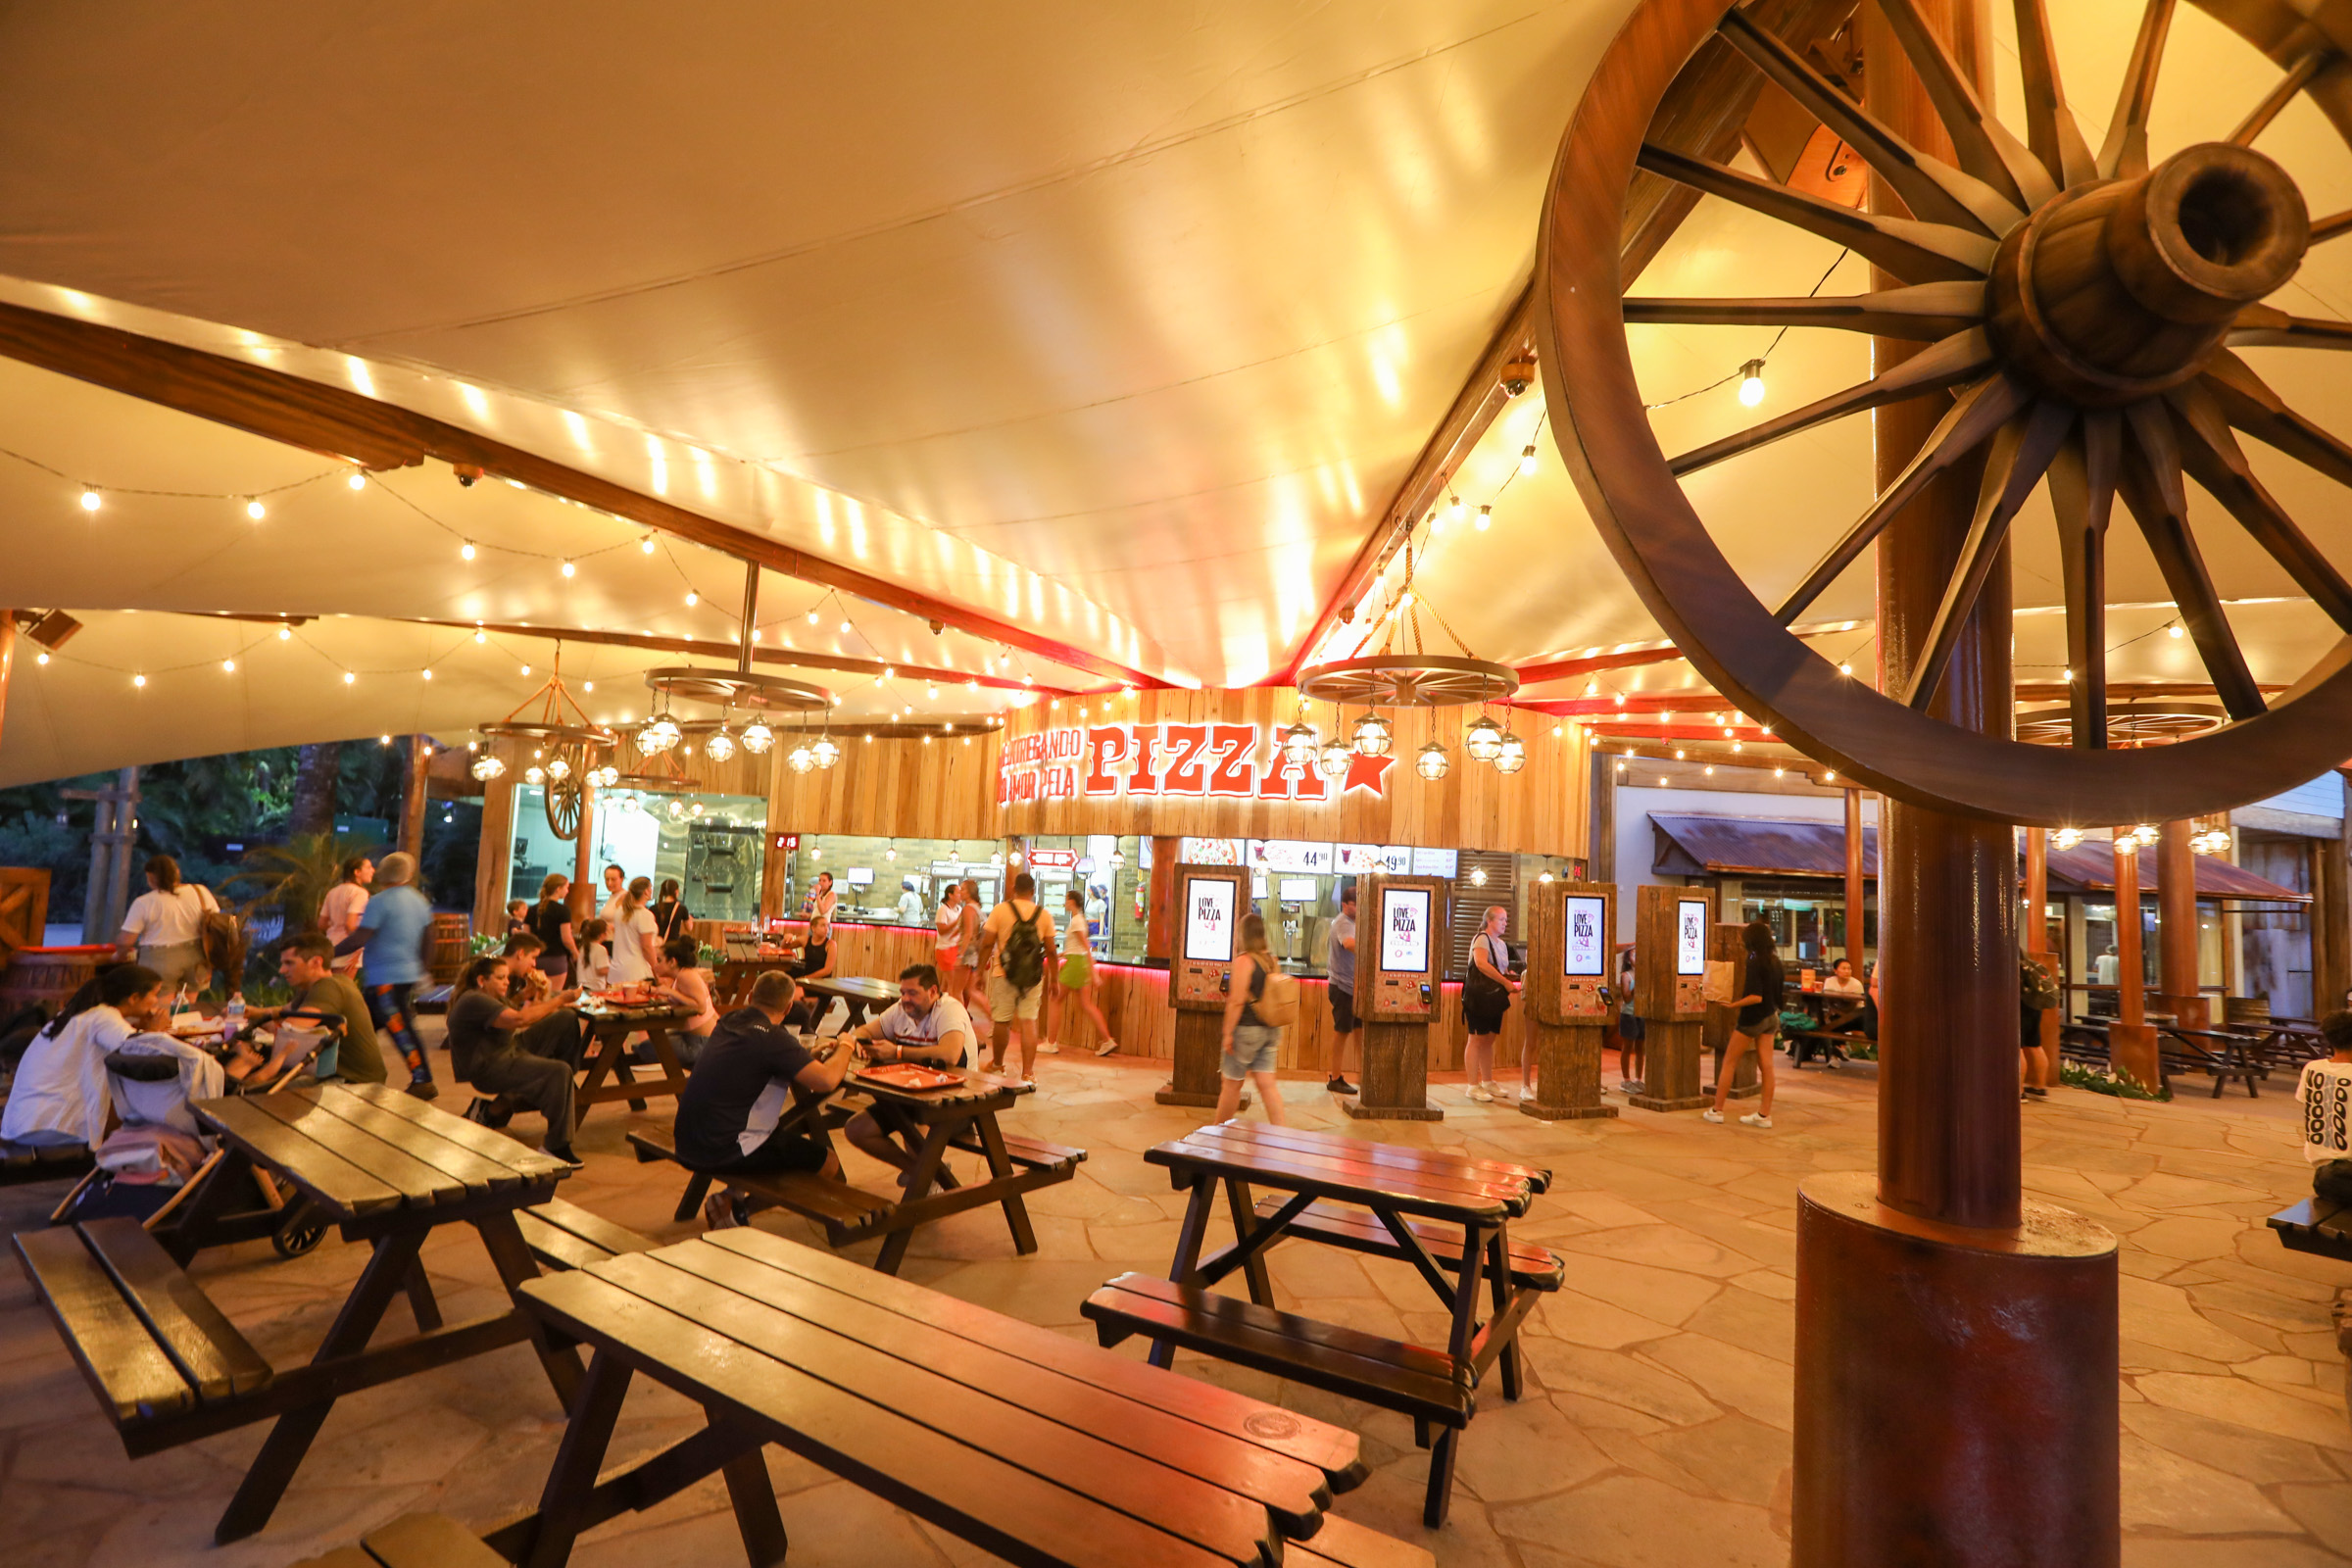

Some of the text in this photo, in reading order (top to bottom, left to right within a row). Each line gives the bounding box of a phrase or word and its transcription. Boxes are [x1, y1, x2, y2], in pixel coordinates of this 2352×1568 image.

[1084, 724, 1327, 800] PIZZA
[1039, 767, 1075, 799] PELA
[1199, 897, 1213, 907] LOVE
[1199, 907, 1221, 921] PIZZA
[1394, 906, 1409, 918] LOVE
[1574, 913, 1587, 924] LOVE
[1393, 918, 1416, 932] PIZZA
[1574, 924, 1593, 937] PIZZA
